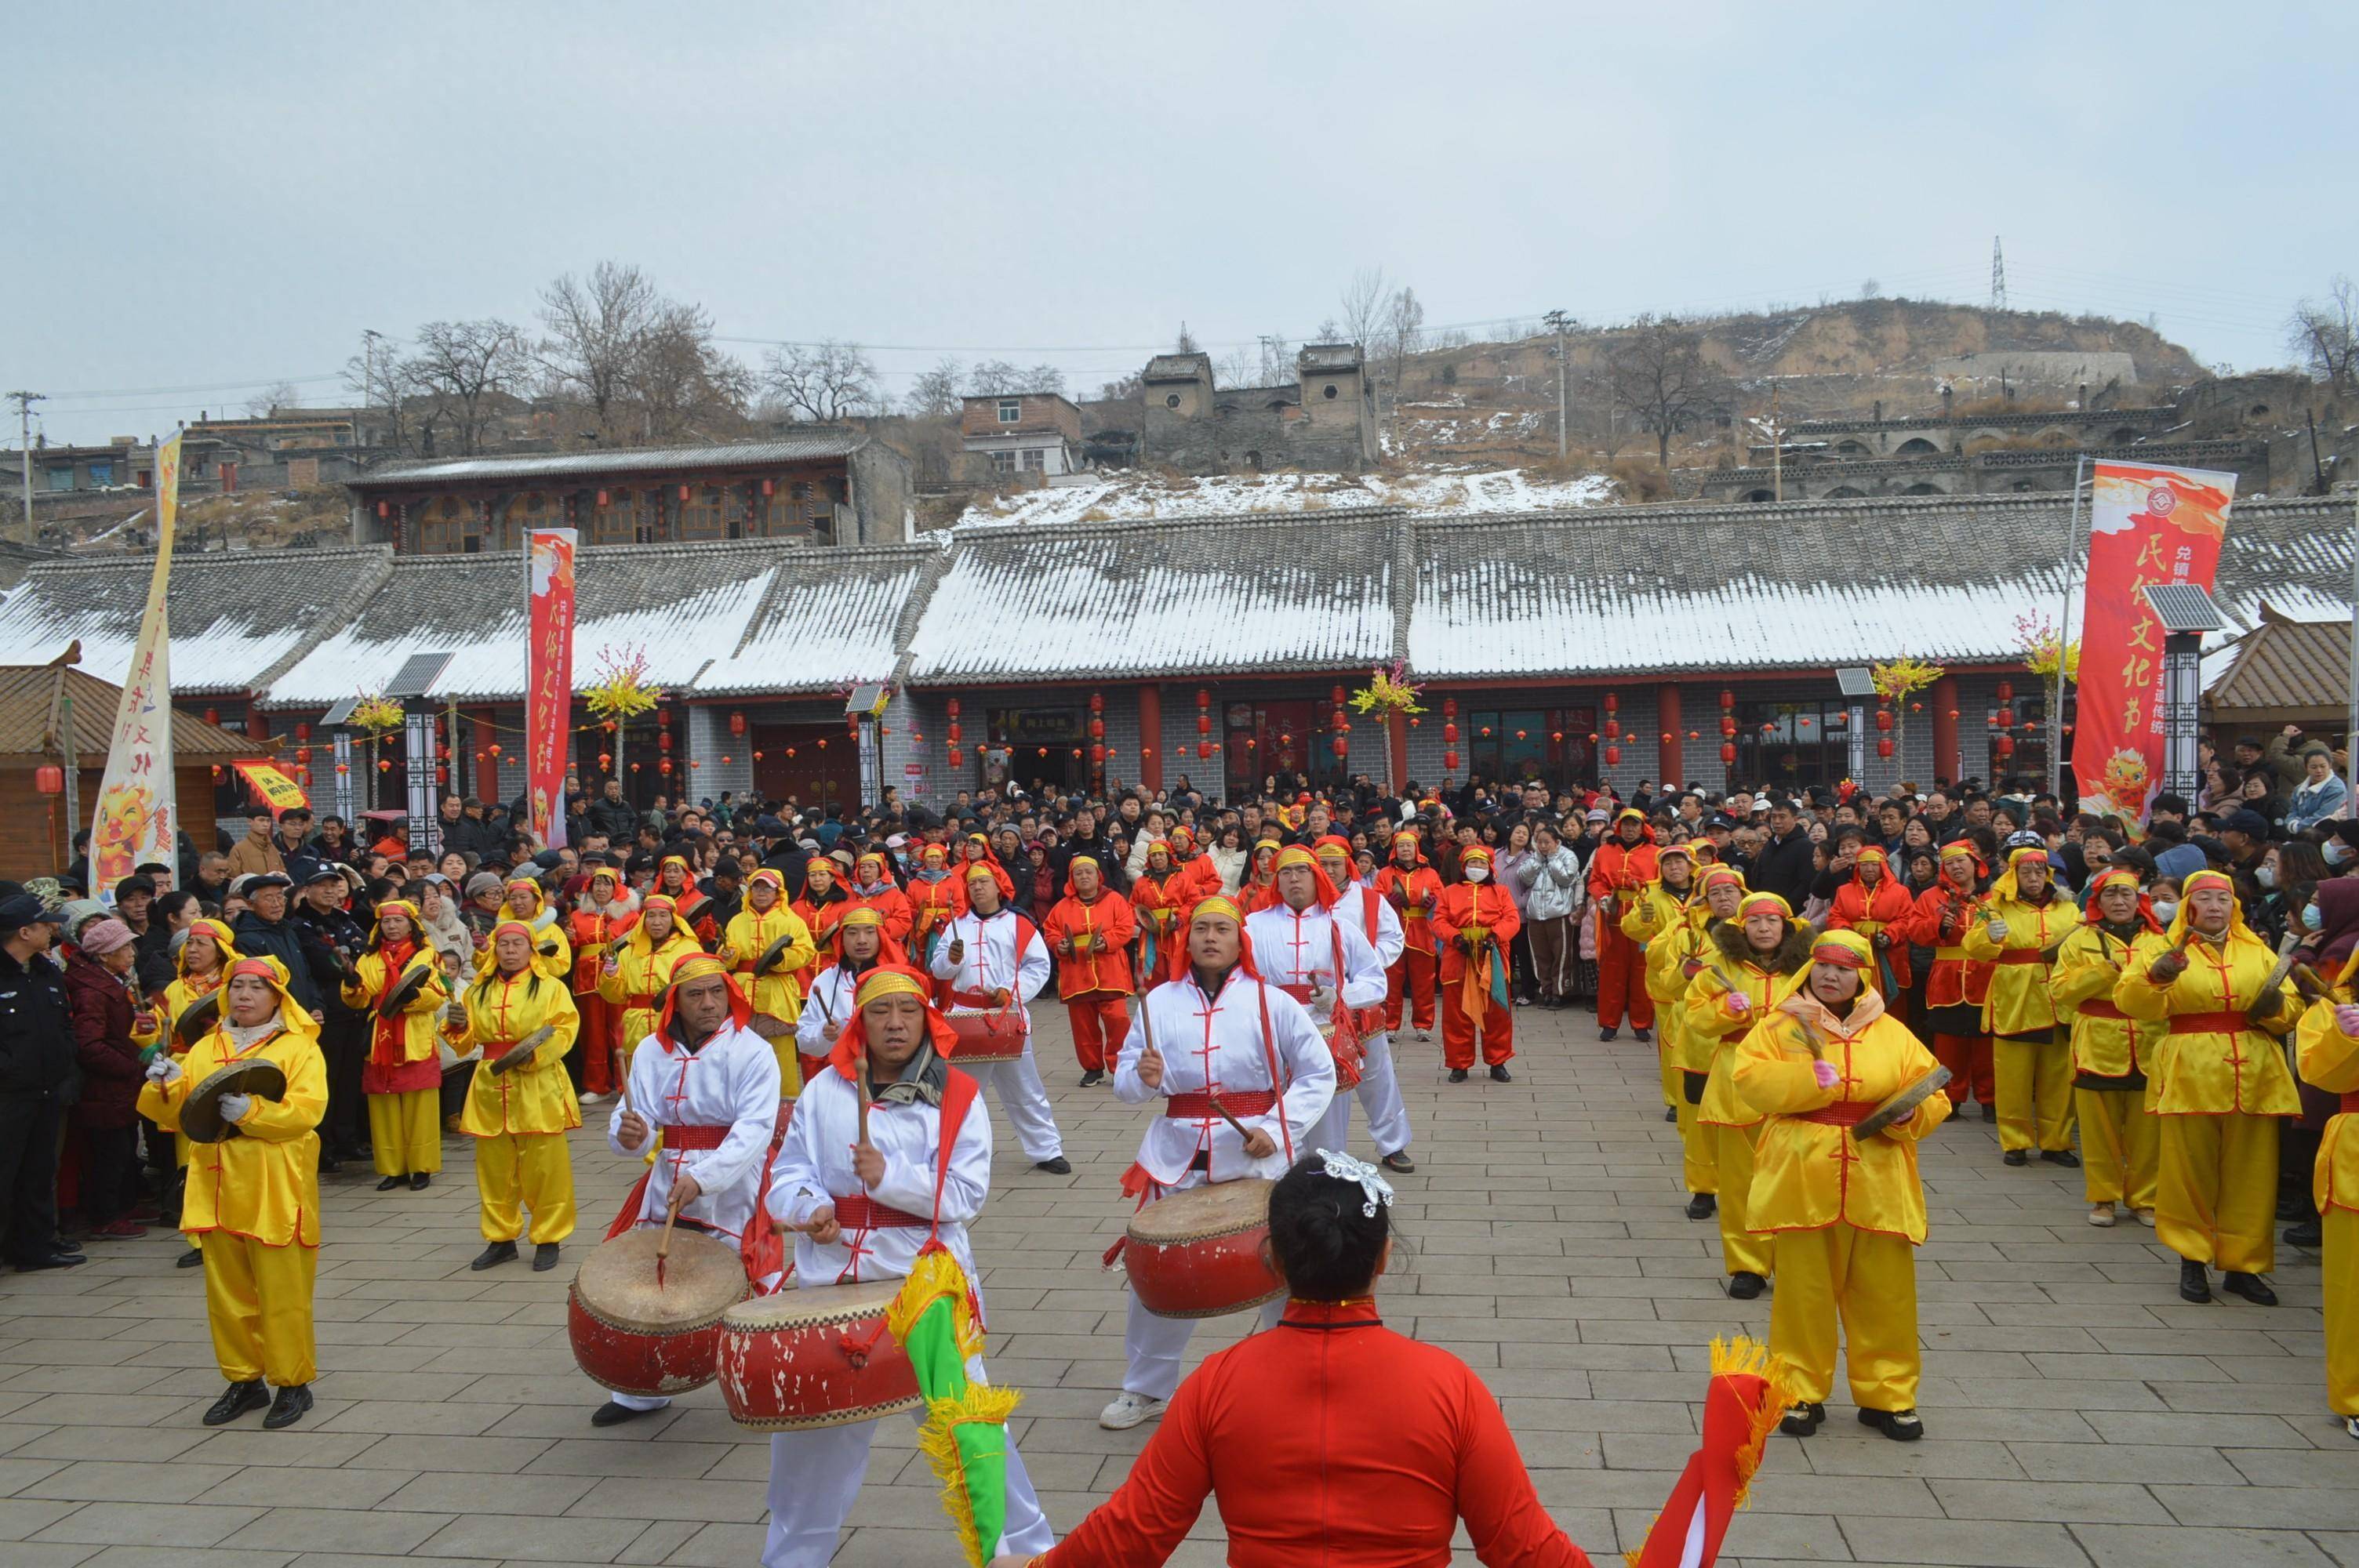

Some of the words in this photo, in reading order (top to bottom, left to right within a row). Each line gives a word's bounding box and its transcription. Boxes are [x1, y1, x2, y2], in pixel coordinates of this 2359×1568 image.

[2122, 533, 2167, 734] 民俗文化节
